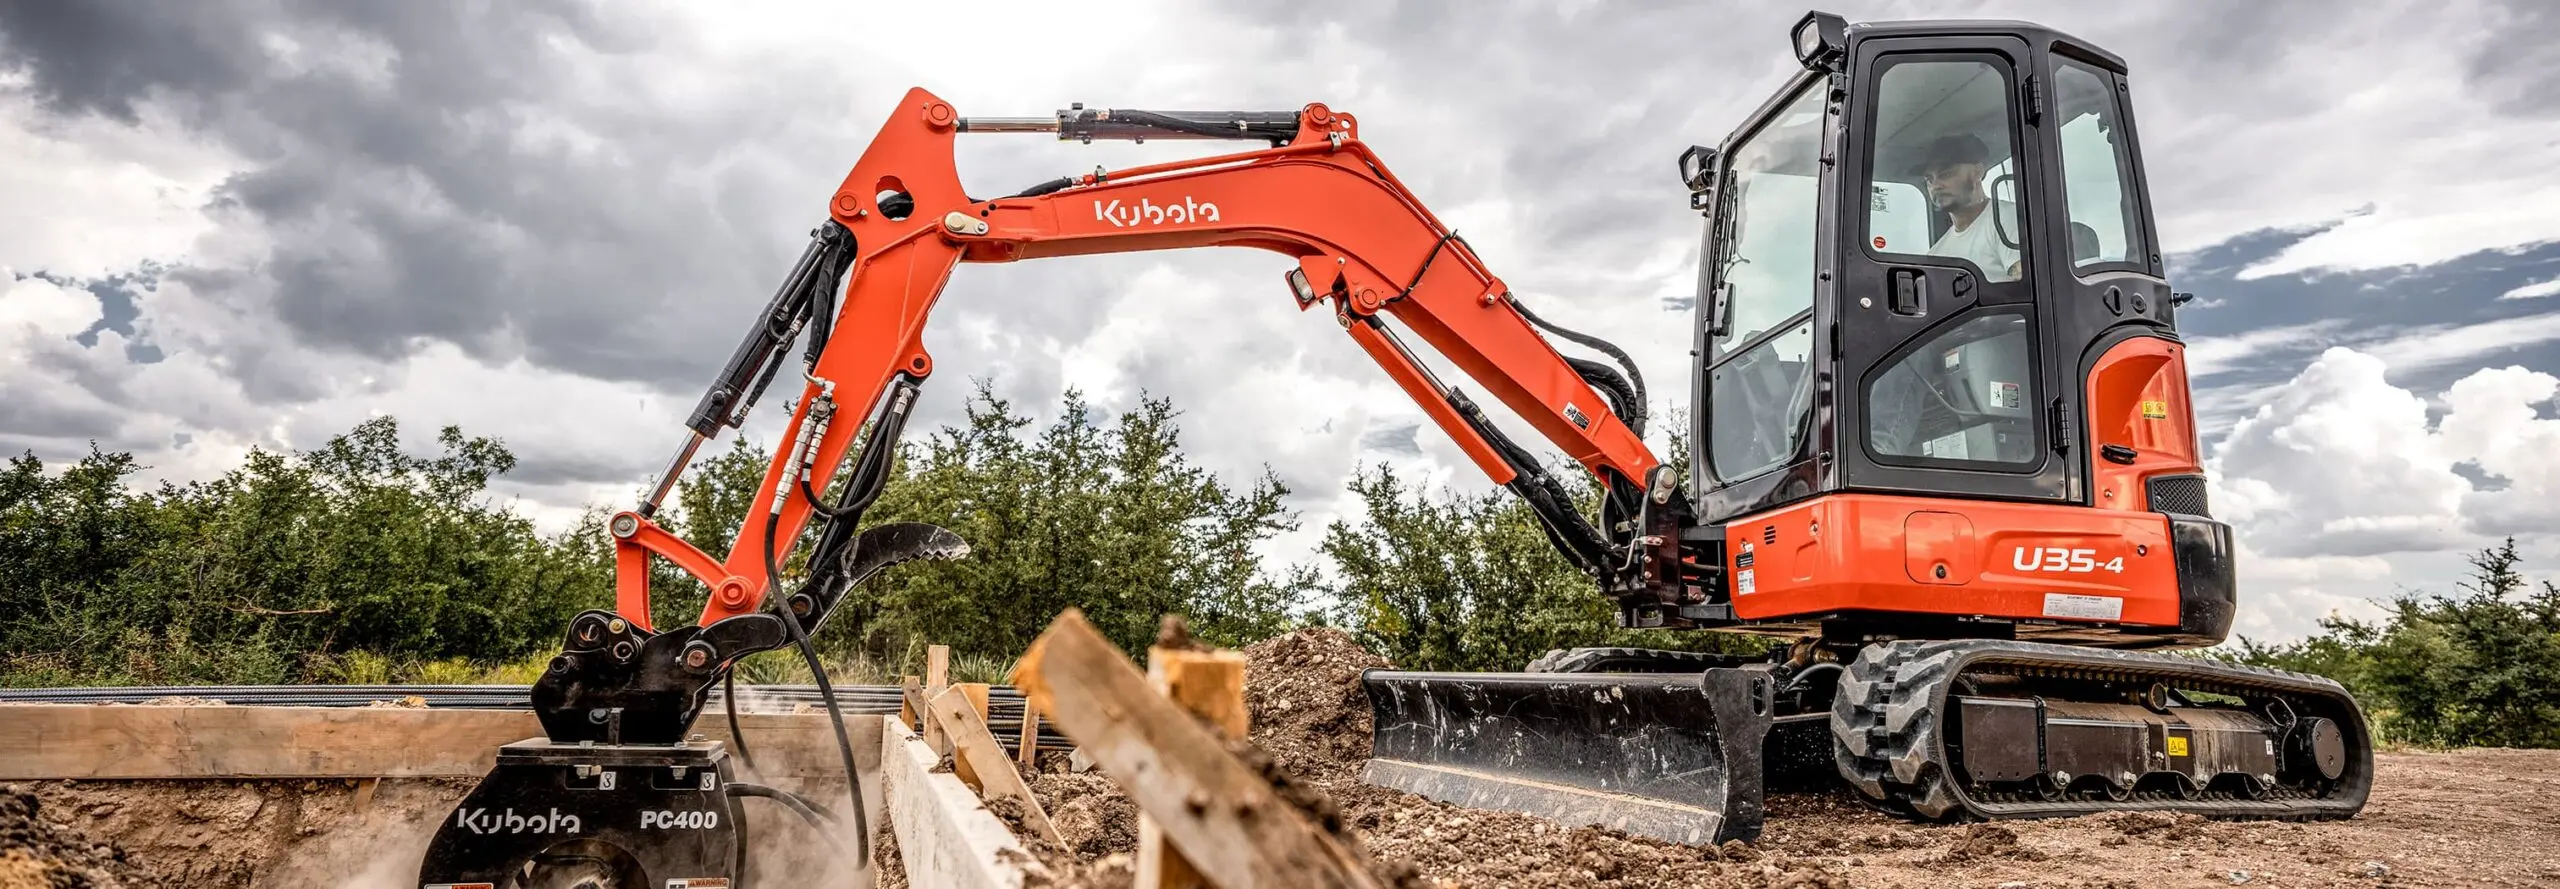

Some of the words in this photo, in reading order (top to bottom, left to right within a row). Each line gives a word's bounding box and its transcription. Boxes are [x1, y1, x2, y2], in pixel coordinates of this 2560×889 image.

[1093, 195, 1220, 228] Kubota
[2013, 546, 2124, 574] U35-4
[457, 807, 581, 834] Kubota
[640, 810, 718, 829] PC400
